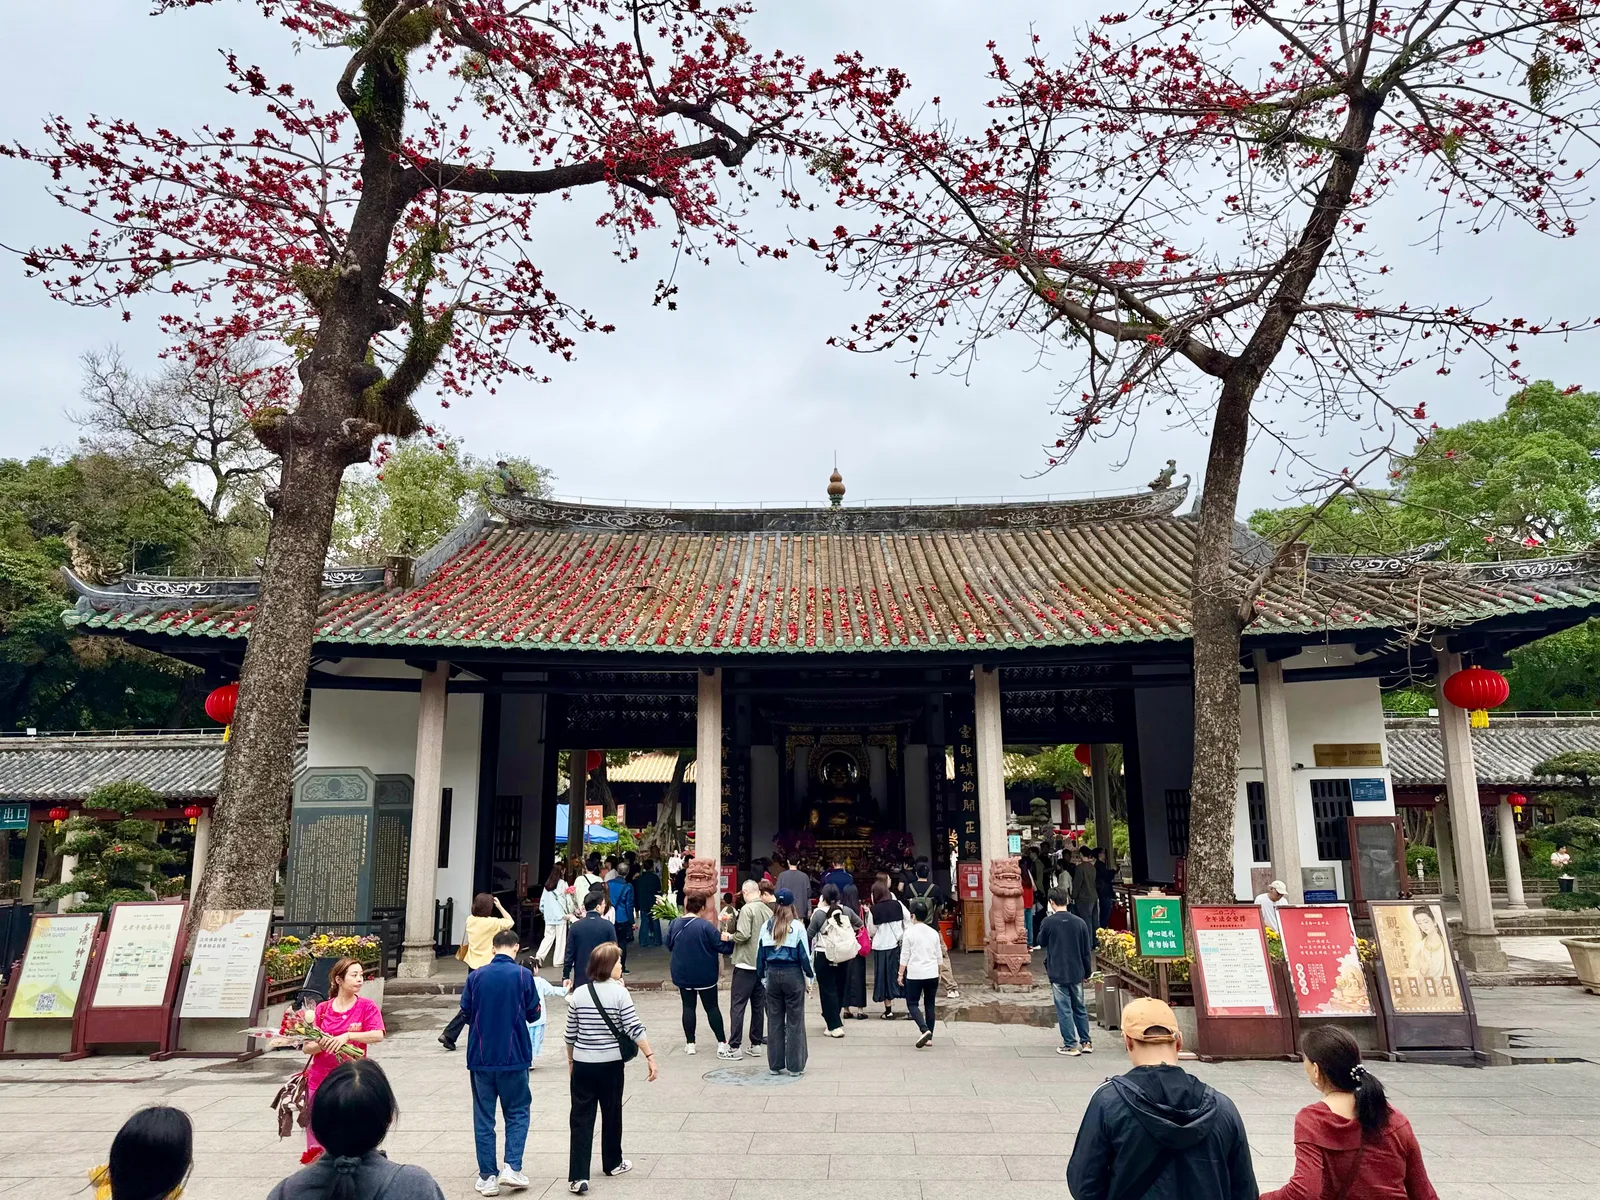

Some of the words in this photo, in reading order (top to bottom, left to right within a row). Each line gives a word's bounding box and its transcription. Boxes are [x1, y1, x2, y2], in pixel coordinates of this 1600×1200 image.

[4, 808, 27, 819] 出口
[585, 808, 600, 818] 花处
[1148, 940, 1177, 949] 请勿拍摄
[69, 922, 91, 982] 多语种导览
